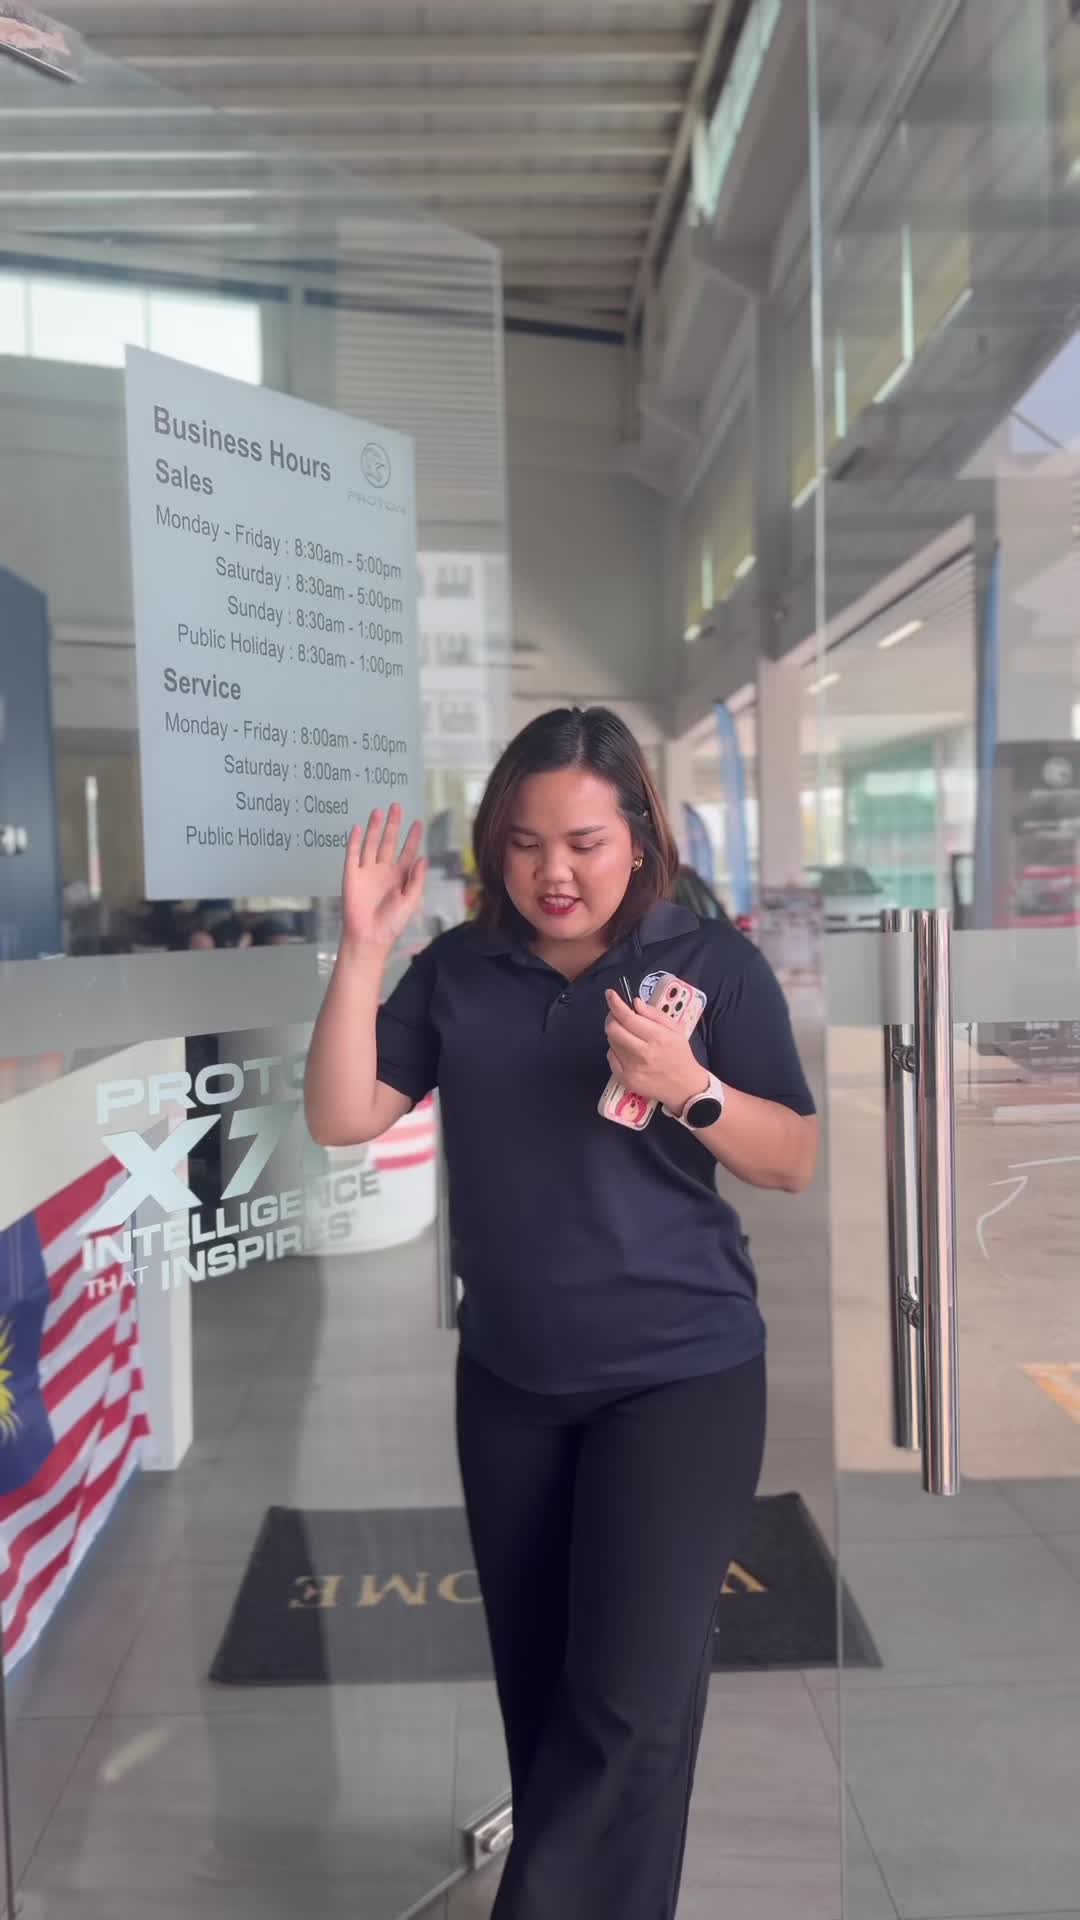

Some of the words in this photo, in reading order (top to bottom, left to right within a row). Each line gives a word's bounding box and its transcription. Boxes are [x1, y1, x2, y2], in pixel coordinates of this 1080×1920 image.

[154, 405, 262, 462] Business
[270, 440, 331, 482] Hours
[155, 458, 214, 495] Sales
[155, 505, 219, 542] Monday
[235, 524, 280, 556] Friday
[295, 538, 344, 567] 8:30am
[356, 553, 401, 580] 5:00pm
[216, 556, 282, 590] Saturday
[296, 573, 344, 600] 8:30am
[358, 587, 402, 612] 5:00pm
[228, 596, 283, 624] Sunday
[296, 609, 344, 634] 8:30am
[358, 620, 403, 645] 1:00pm
[178, 623, 225, 649] Public
[231, 632, 284, 663] Holiday
[298, 643, 346, 668] 8:30am
[360, 654, 404, 678] 1:00pm
[163, 667, 241, 700] Service
[165, 711, 228, 741] Monday
[244, 720, 288, 747] Friday
[300, 726, 349, 749] 8:00am
[362, 732, 407, 757] 5:00pm
[224, 754, 289, 782] Saturday
[304, 761, 350, 782] 8:00am
[364, 766, 408, 786] 1:00pm
[236, 791, 291, 816] Sunday
[304, 796, 348, 815] Closed
[186, 825, 233, 847] Public
[238, 828, 292, 851] Holiday
[304, 829, 348, 848] Closed
[78, 1103, 297, 1237] X7
[83, 1170, 381, 1272] INTELLIGENCE
[86, 1266, 150, 1298] THAT
